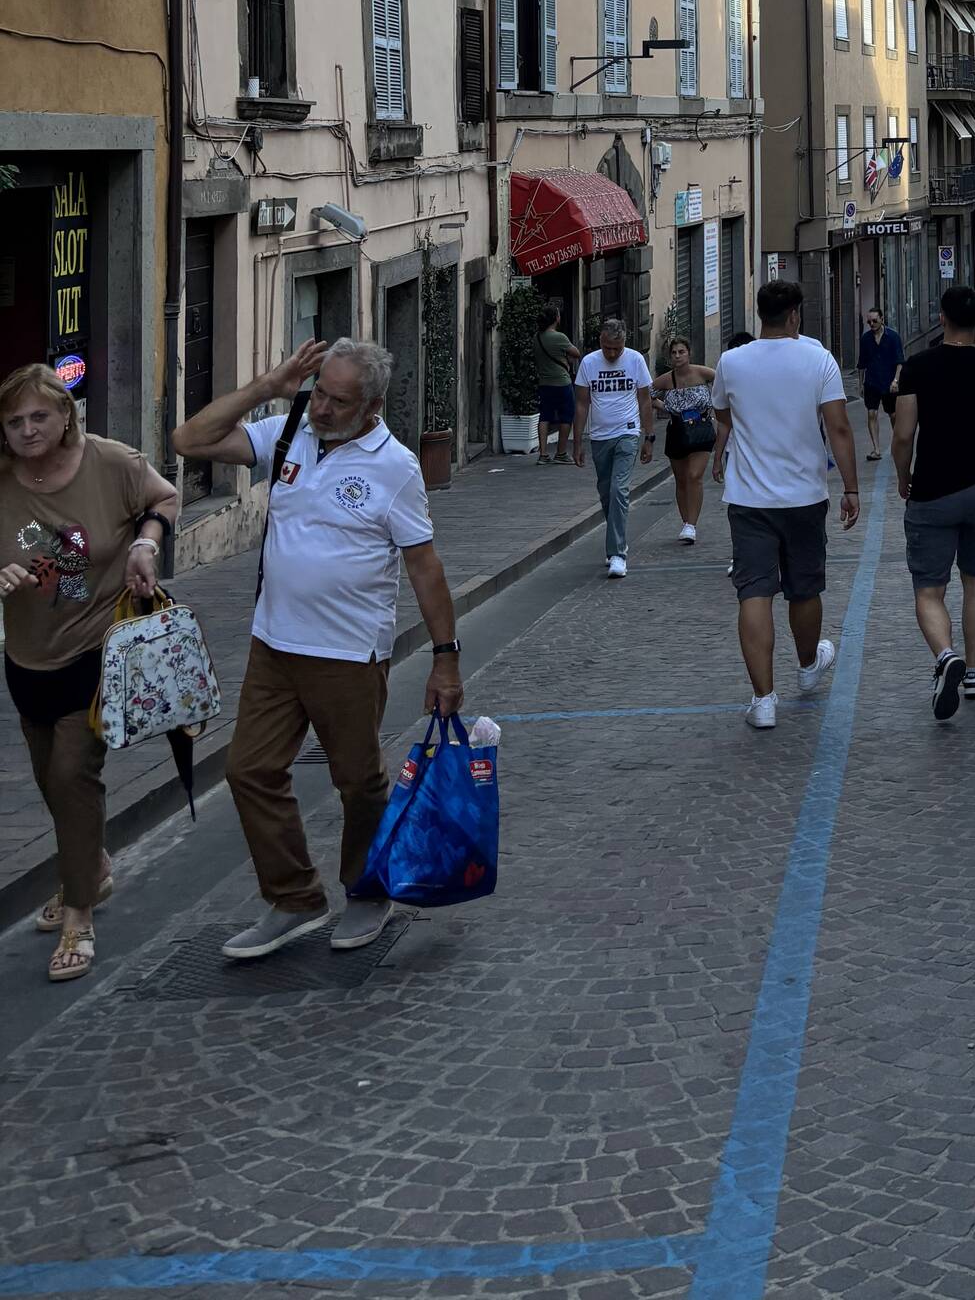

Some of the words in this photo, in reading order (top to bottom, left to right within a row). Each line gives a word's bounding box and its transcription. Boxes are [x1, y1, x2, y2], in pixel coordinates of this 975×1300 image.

[55, 171, 88, 219] SALA
[867, 223, 908, 235] HOTEL
[54, 228, 88, 278] SLOT
[525, 258, 544, 274] TEL.
[543, 253, 556, 268] 329
[57, 286, 82, 336] VLT
[340, 476, 365, 485] CANADA
[335, 487, 346, 506] NORTH
